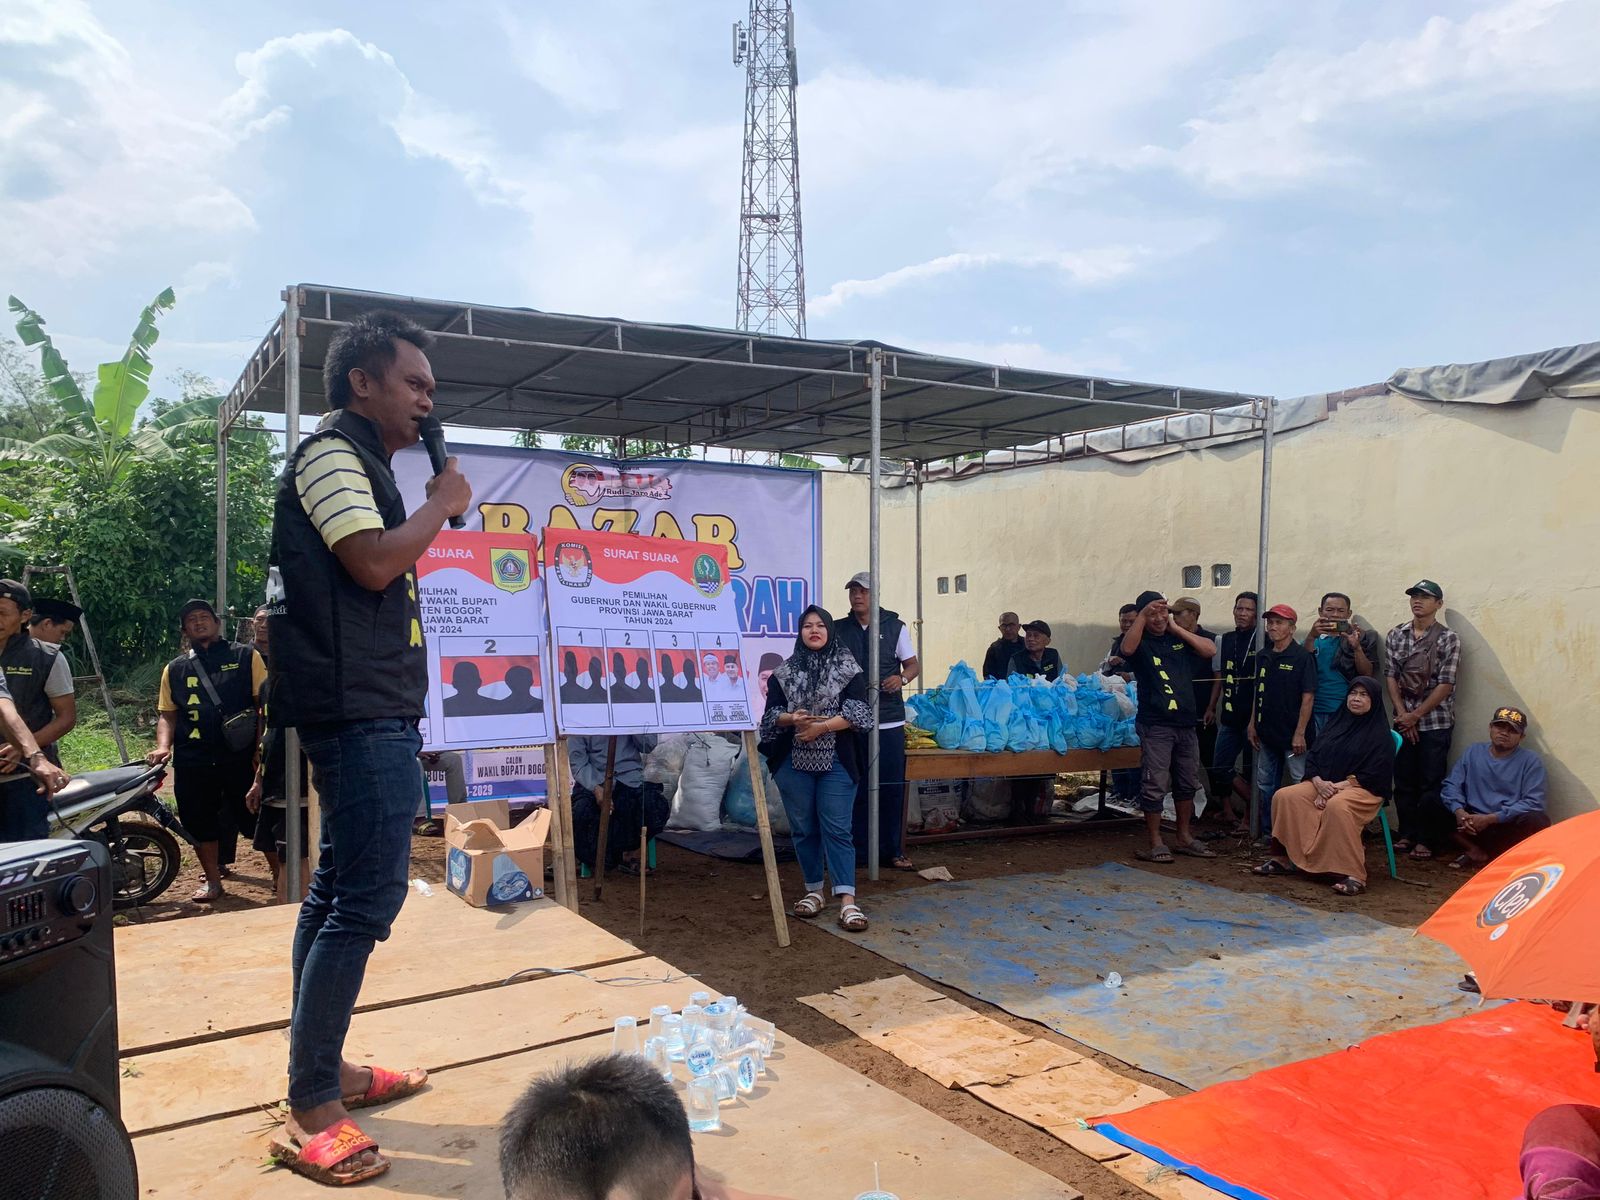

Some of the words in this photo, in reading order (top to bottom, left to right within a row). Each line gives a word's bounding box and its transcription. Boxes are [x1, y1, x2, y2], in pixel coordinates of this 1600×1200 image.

[428, 548, 474, 559] SUARA
[603, 548, 639, 560] SURAT
[642, 551, 679, 564] SUARA
[623, 590, 668, 600] PEMILIHAN
[427, 597, 459, 606] WAKIL
[462, 597, 497, 606] BUPATI
[571, 596, 621, 607] GUBERNUR
[623, 599, 641, 607] DAN
[644, 601, 670, 609] WAKIL
[672, 602, 717, 611] GUBERNUR
[730, 575, 808, 638] RAH
[421, 606, 443, 615] TEN
[444, 607, 482, 615] BOGOR
[599, 607, 640, 616] PROVINSI
[642, 609, 666, 617] JAWA
[667, 610, 694, 618] BARAT
[424, 616, 455, 624] JAWA
[455, 616, 489, 624] BARAT
[624, 617, 653, 625] TAHUN
[655, 618, 673, 626] 2024
[423, 626, 437, 634] UN
[440, 626, 462, 634] 2024
[578, 631, 583, 644] 1
[624, 633, 631, 645] 2
[672, 635, 678, 647] 3
[716, 635, 722, 647] 4
[484, 639, 497, 654] 2
[187, 676, 200, 739] RAJA
[505, 756, 522, 765] CALON
[477, 766, 499, 778] WAKIL
[501, 764, 526, 776] BUPATI
[528, 763, 546, 775] BOGO
[1494, 881, 1530, 919] Cleo
[331, 1135, 372, 1157] adidas
